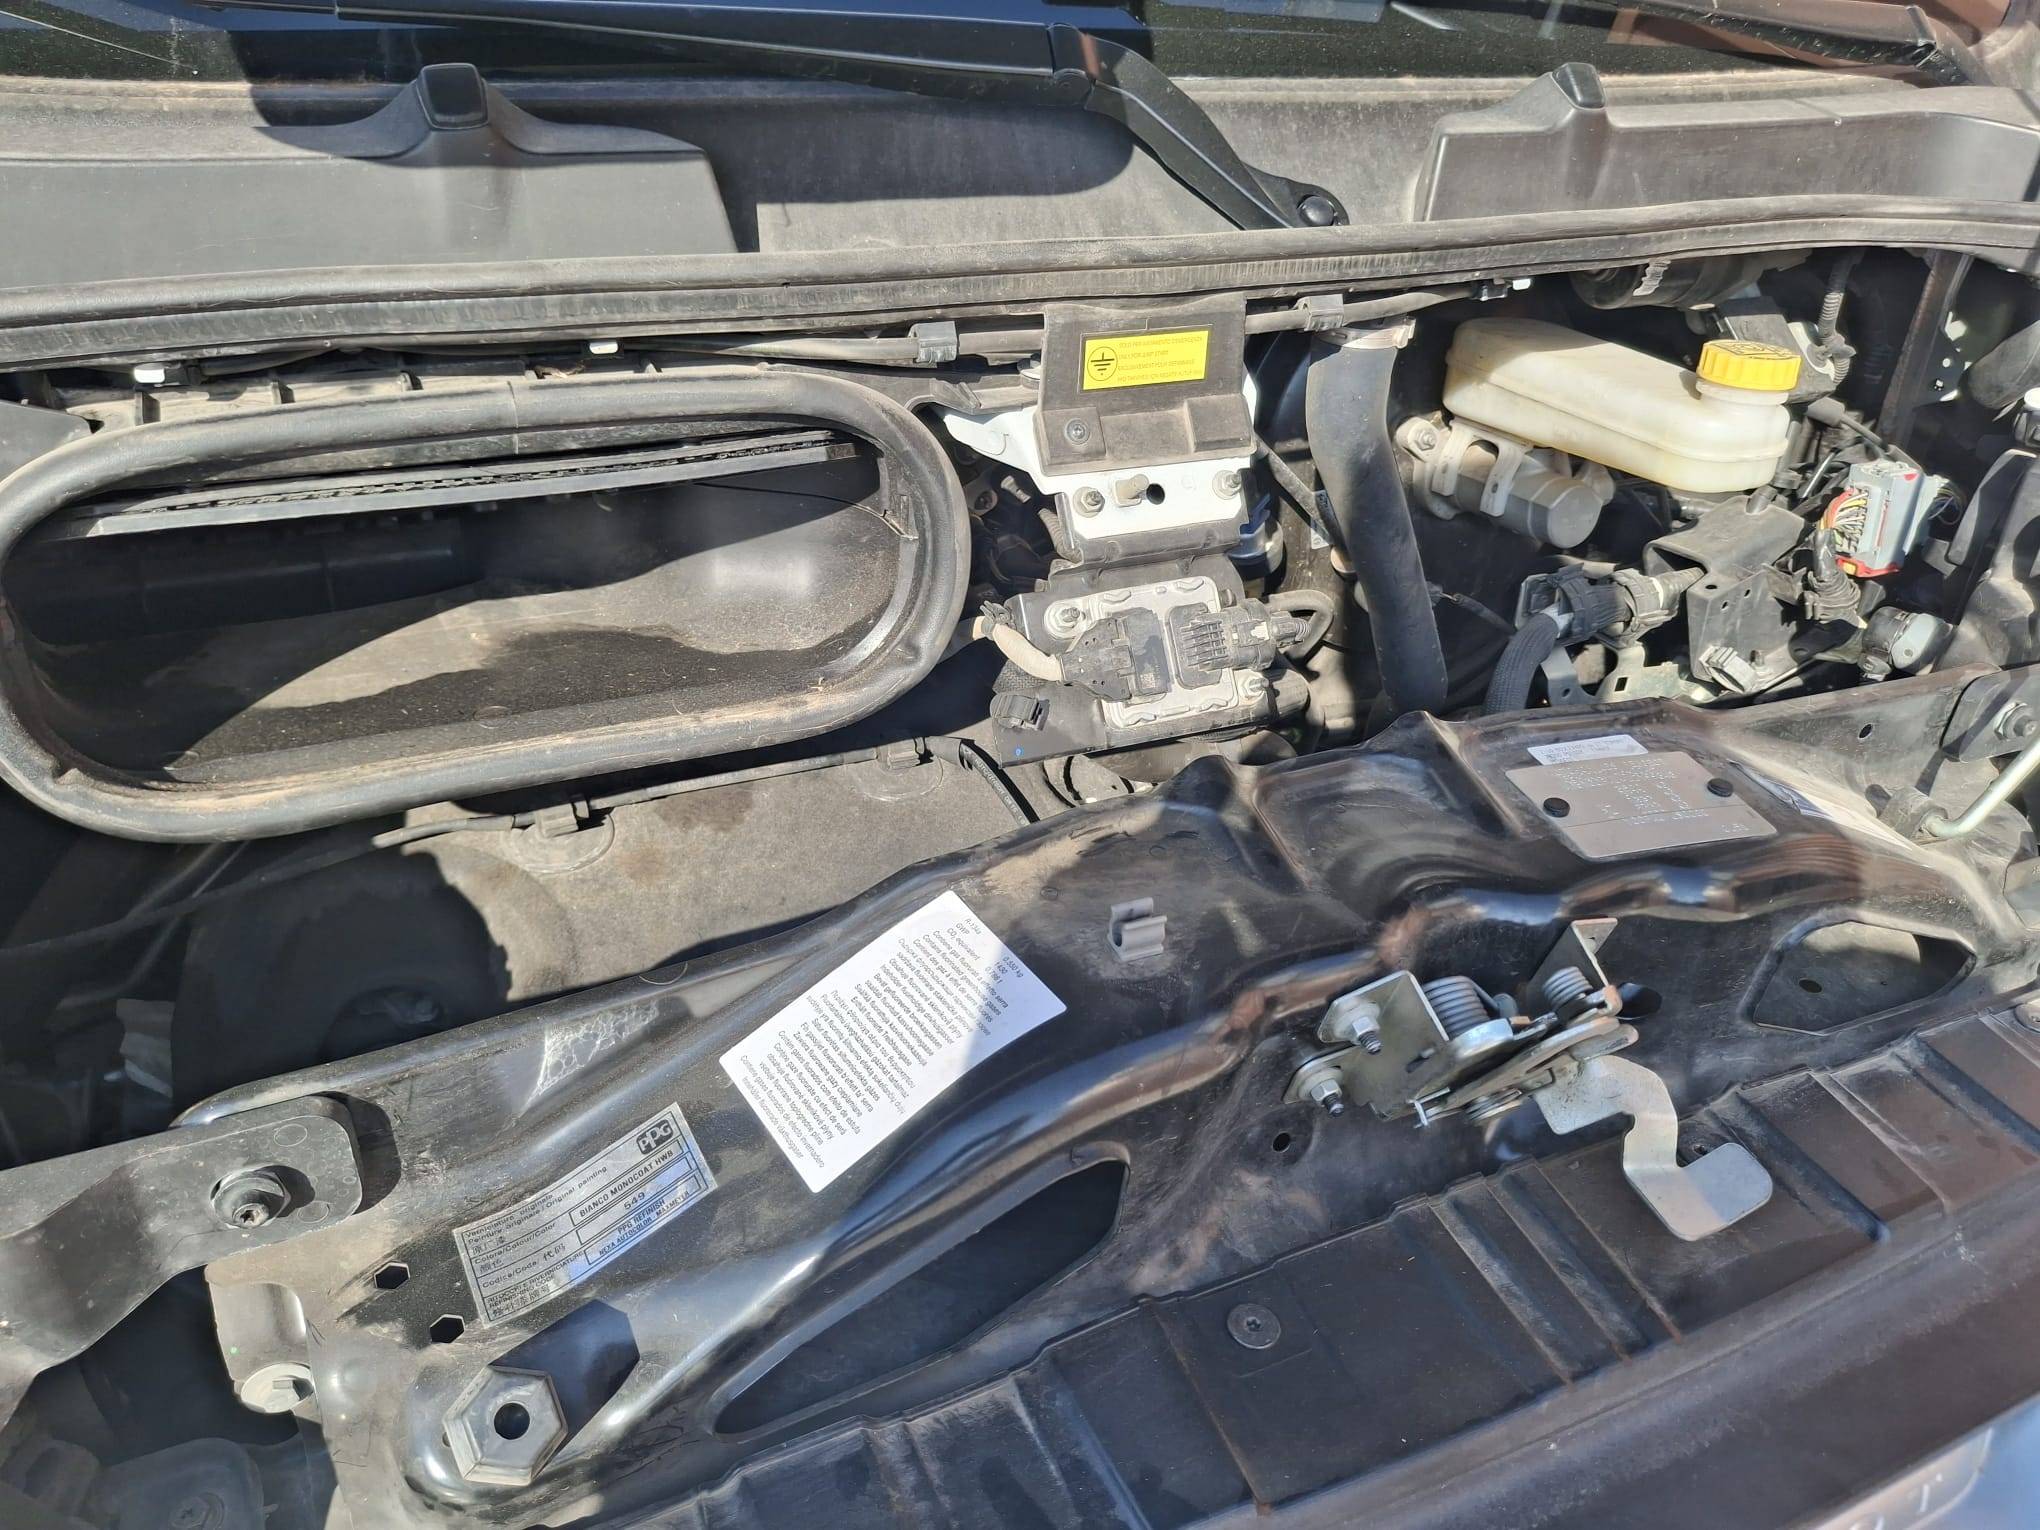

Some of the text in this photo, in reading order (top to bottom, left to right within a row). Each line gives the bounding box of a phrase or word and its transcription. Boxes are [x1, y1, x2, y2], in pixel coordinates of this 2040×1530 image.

[637, 1124, 672, 1152] PPG
[578, 1166, 607, 1189] painting
[579, 1151, 673, 1217] BIANCO MONOCOAT HWB
[624, 1192, 645, 1210] 549
[617, 1200, 665, 1234] PPG REFINISH
